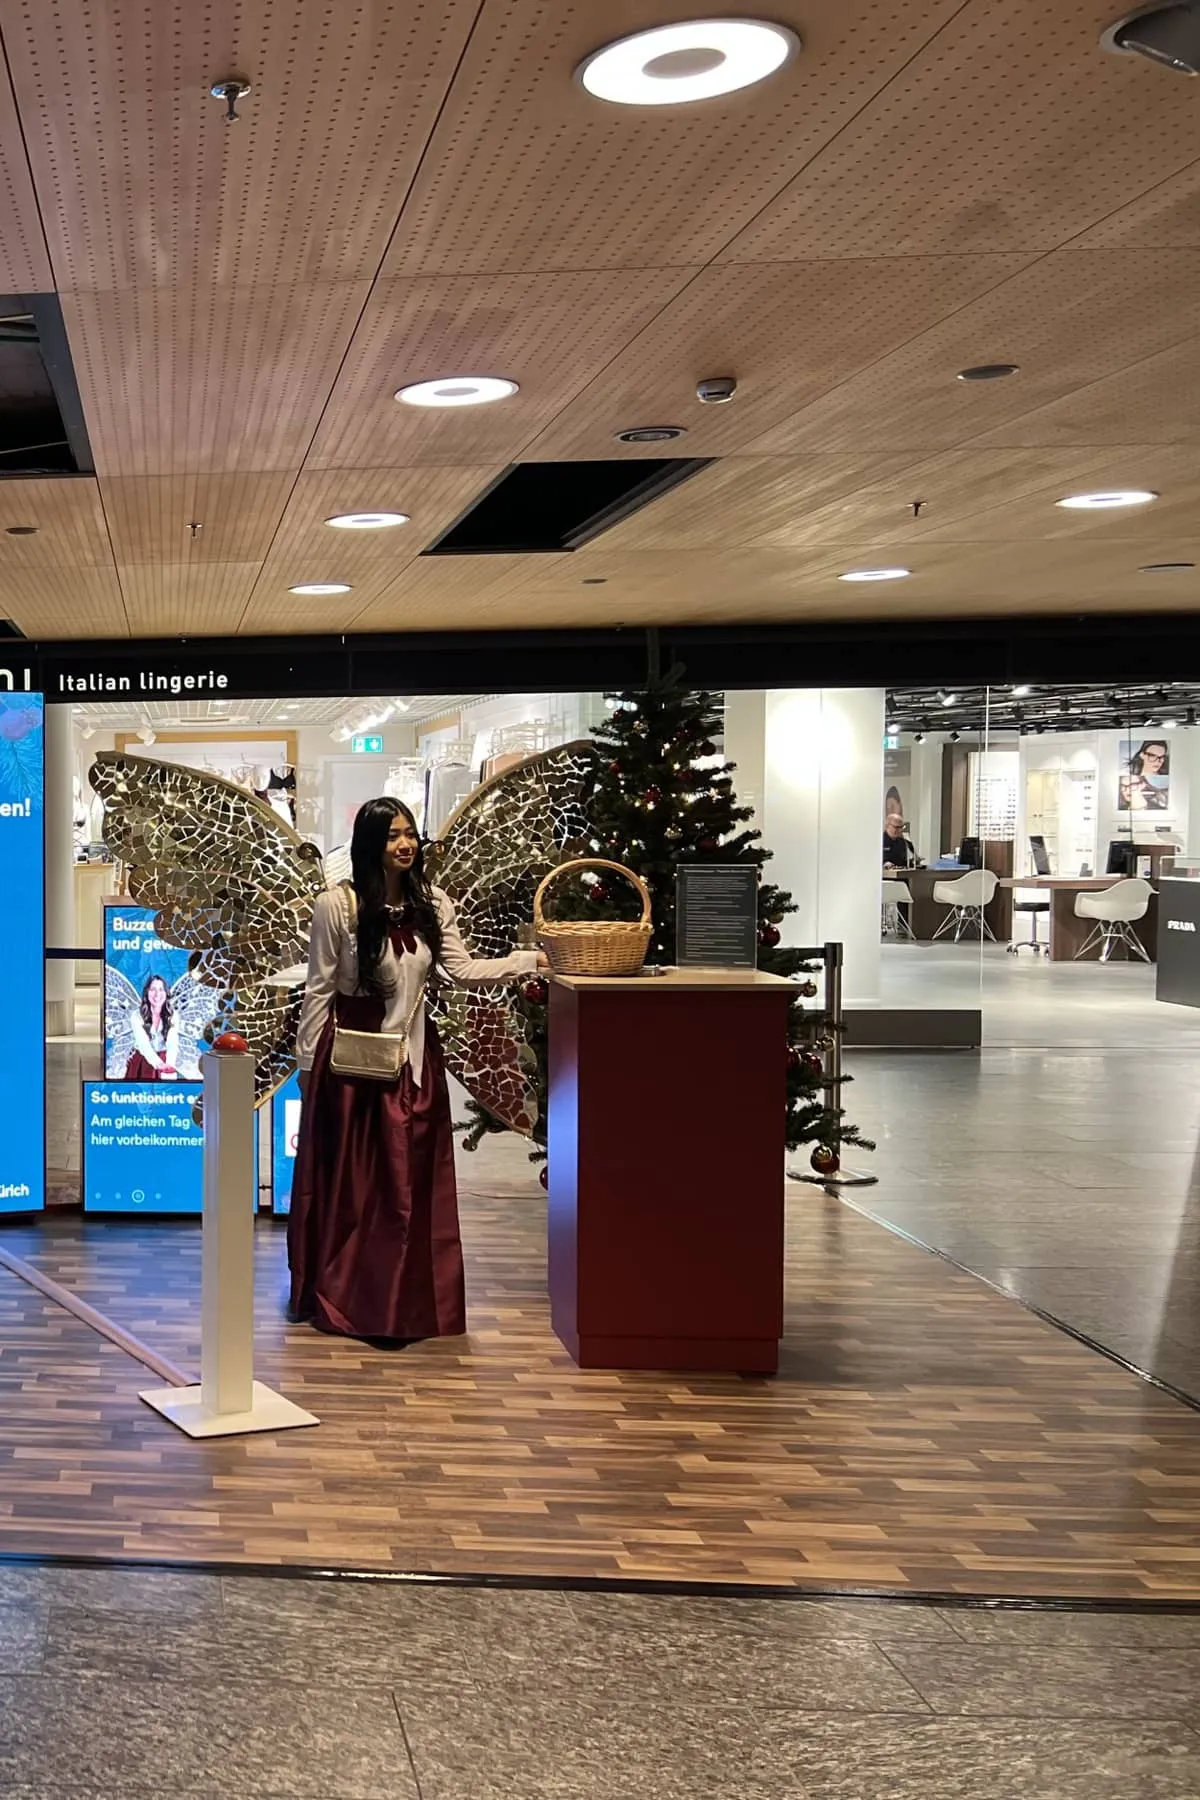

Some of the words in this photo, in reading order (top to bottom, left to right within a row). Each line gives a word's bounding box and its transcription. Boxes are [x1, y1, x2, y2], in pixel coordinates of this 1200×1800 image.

[59, 673, 131, 691] Italian
[140, 670, 228, 693] lingerie
[112, 917, 154, 931] Buzze
[112, 936, 140, 950] und
[90, 1091, 108, 1104] So
[111, 1091, 184, 1104] funktioniert
[90, 1114, 112, 1126] Am
[115, 1115, 165, 1129] gleichen
[168, 1115, 190, 1130] Tag
[91, 1134, 114, 1146] hier
